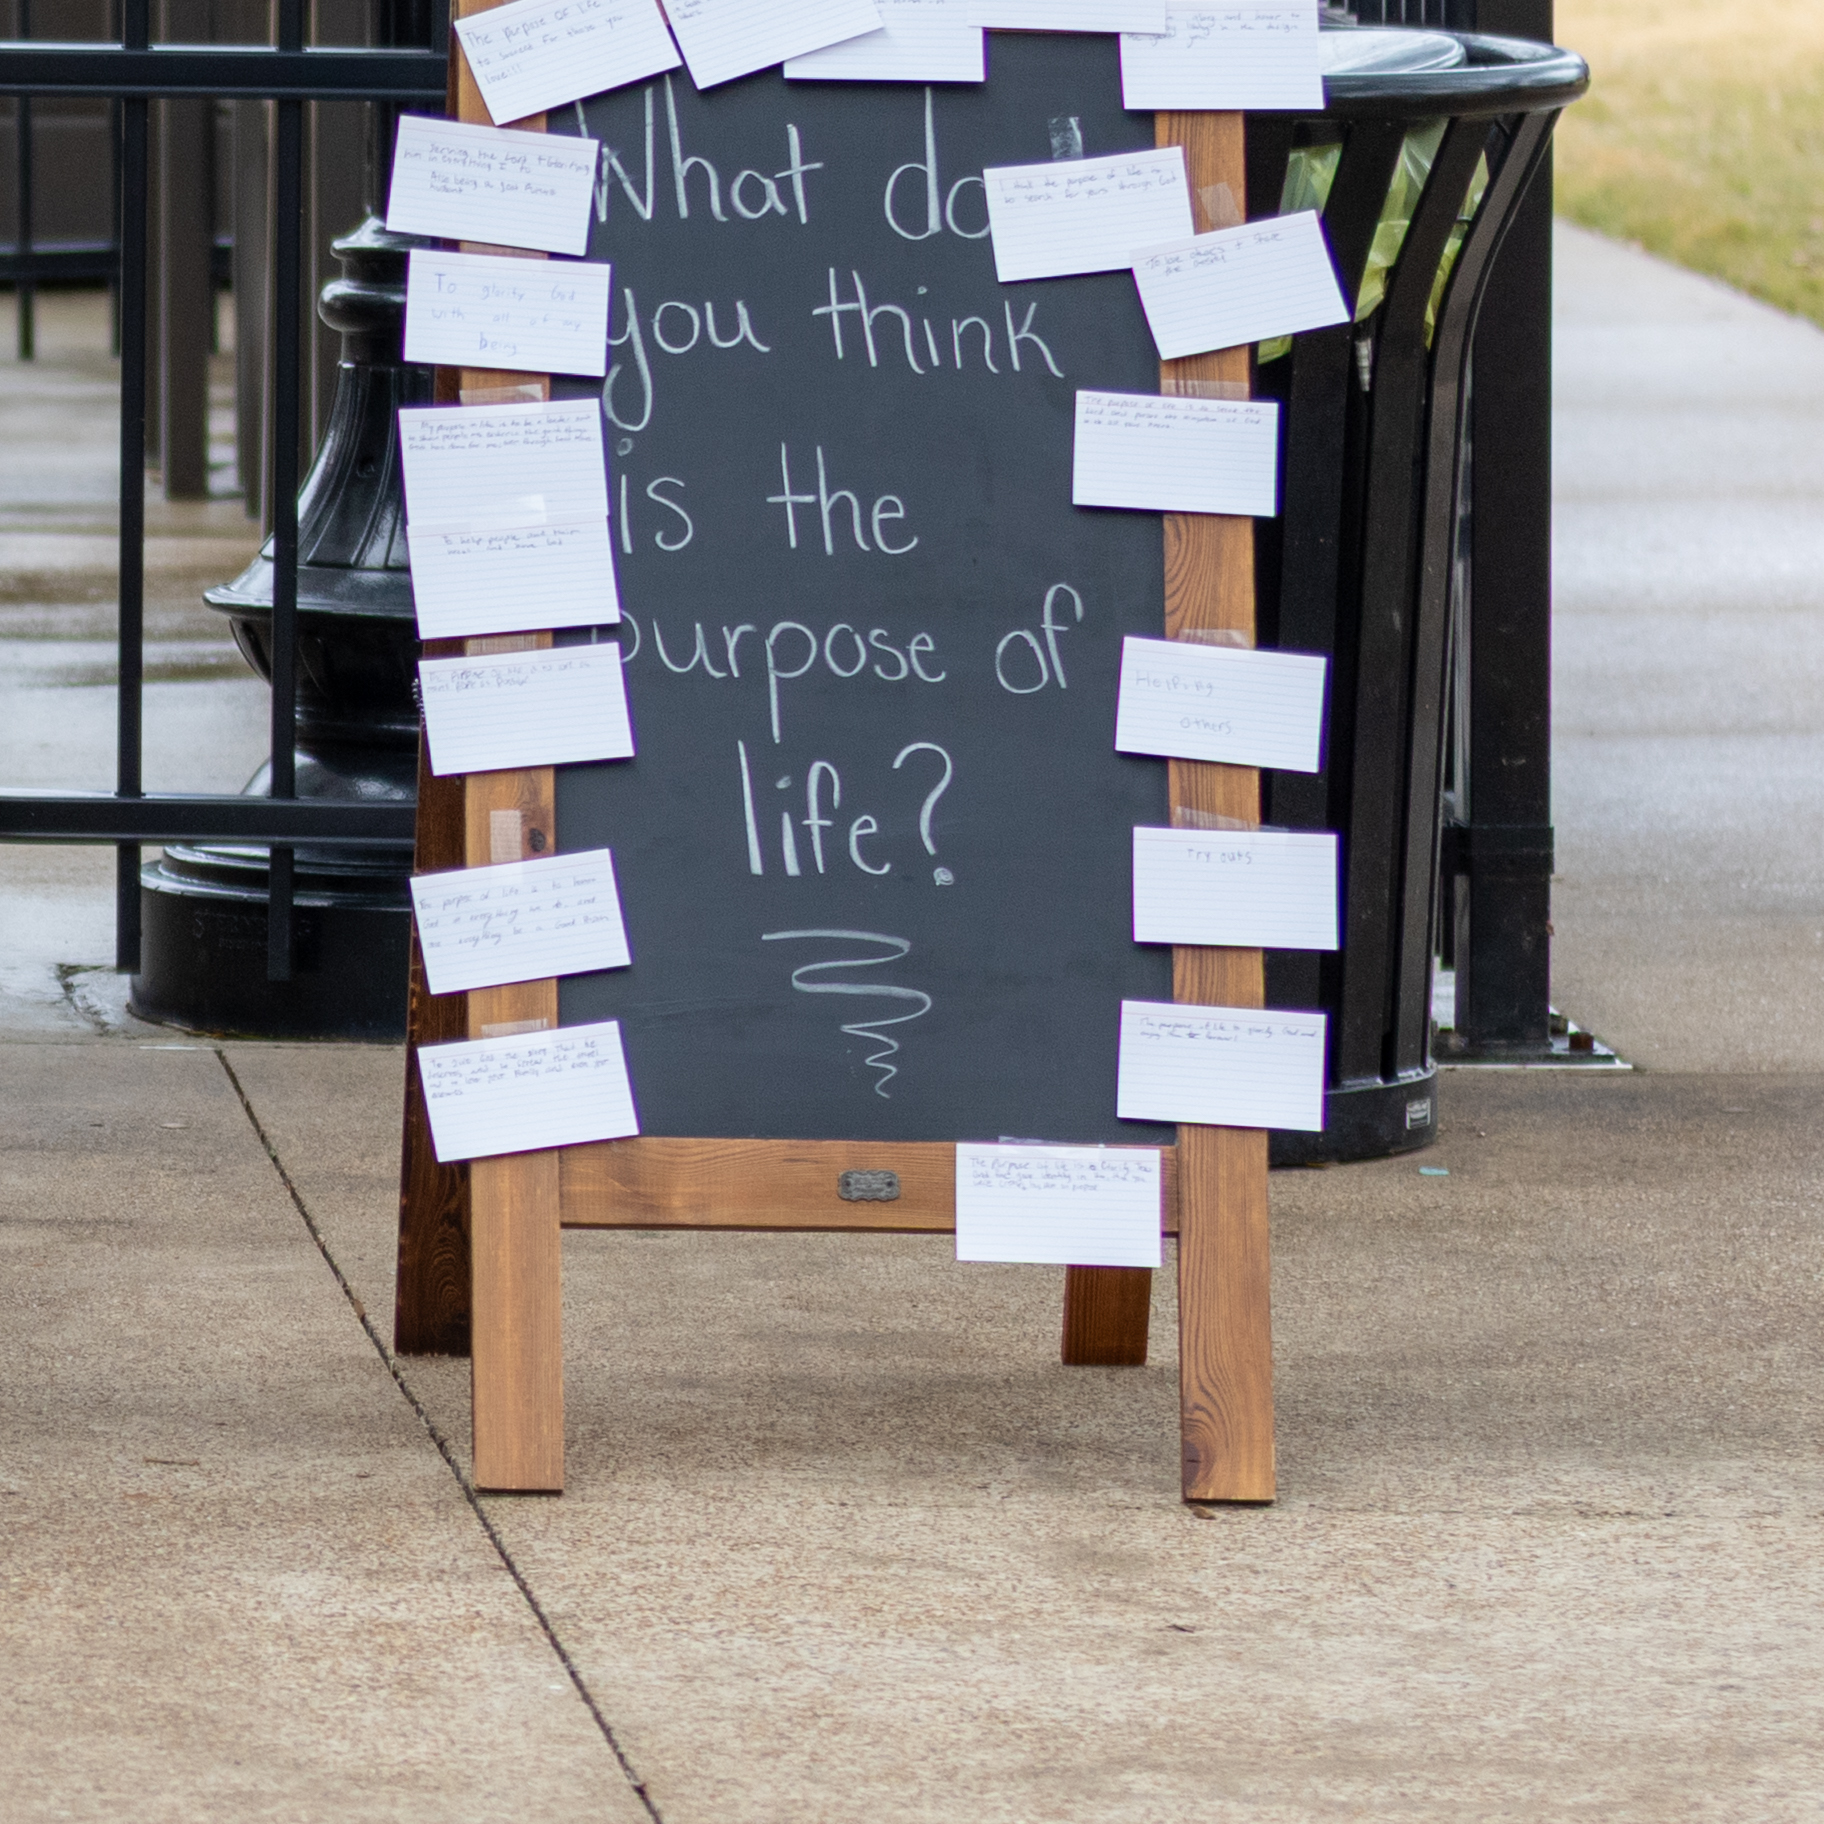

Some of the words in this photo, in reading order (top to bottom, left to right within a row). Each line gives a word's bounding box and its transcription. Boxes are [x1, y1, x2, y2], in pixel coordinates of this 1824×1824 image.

[574, 73, 824, 223] What
[434, 272, 458, 294] To
[602, 288, 772, 431] you
[812, 267, 1065, 378] think
[617, 436, 694, 554] is
[766, 442, 919, 555] the
[995, 583, 1084, 694] of
[737, 739, 955, 885] life?
